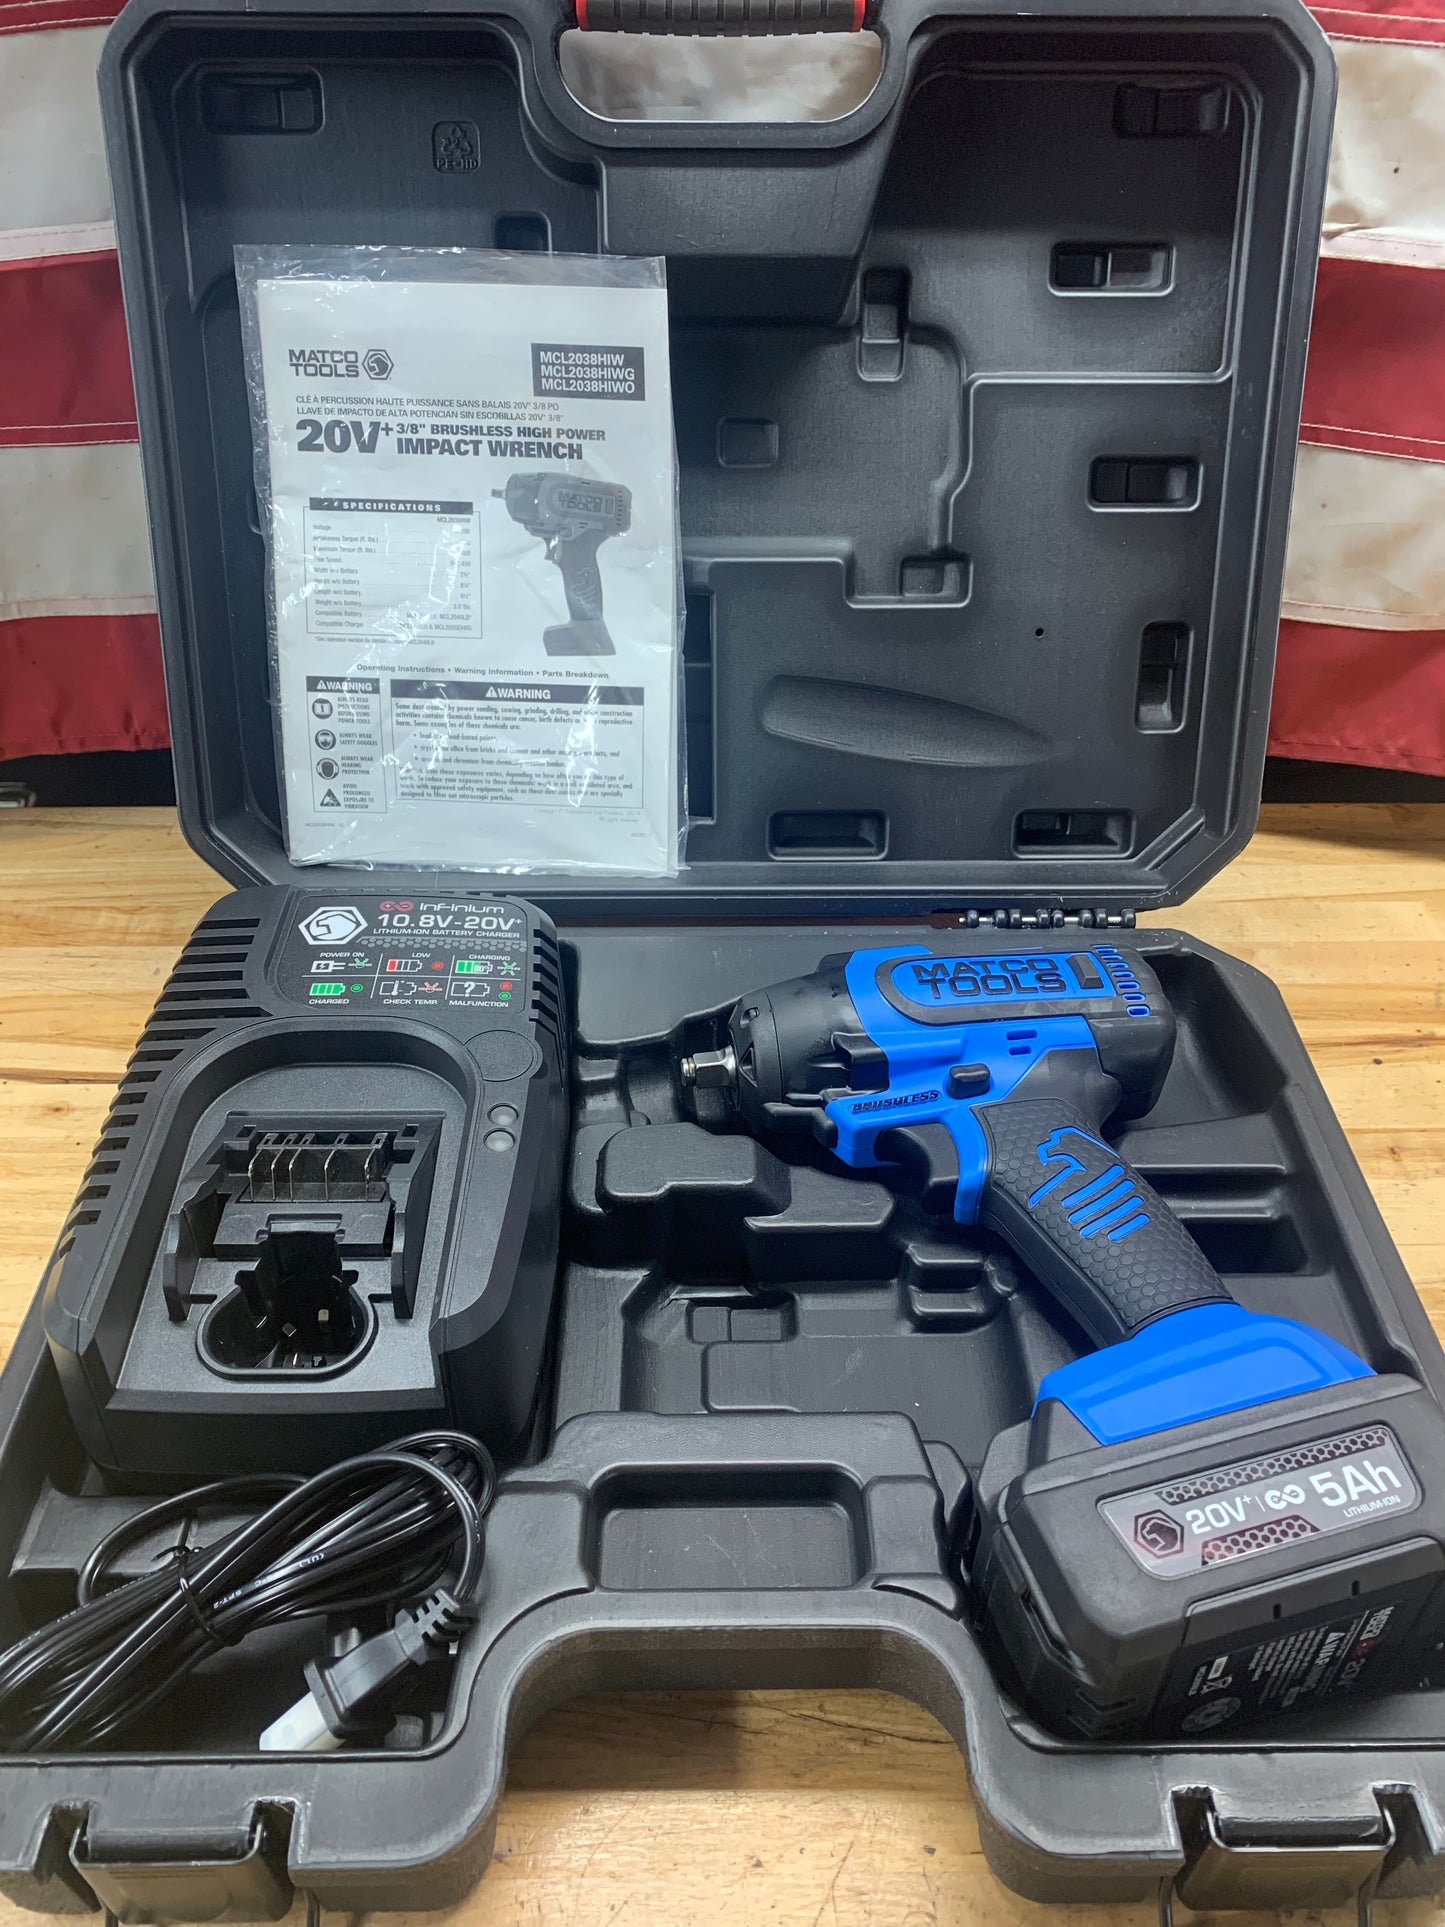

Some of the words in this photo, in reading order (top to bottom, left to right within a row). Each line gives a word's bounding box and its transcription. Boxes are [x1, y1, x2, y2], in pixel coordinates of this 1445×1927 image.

[288, 349, 359, 364] MATCO
[540, 351, 625, 366] MCL2038HIW
[289, 363, 360, 378] TOOLS
[540, 364, 635, 380] MCL2038HIWG
[541, 378, 635, 394] MCL2038HIWO
[295, 393, 311, 404] CLÉ
[320, 396, 374, 405] PERCUSSION
[376, 397, 404, 406] HAUTE
[406, 398, 454, 408] PUISSANCE
[456, 400, 480, 408] SANS
[482, 400, 512, 409] BALAIS
[533, 402, 546, 410] 3/8
[548, 402, 559, 411] PO
[296, 406, 322, 415] LLAVE
[324, 407, 336, 415] DE
[337, 408, 374, 416] IMPACTO
[376, 408, 387, 416] DE
[388, 409, 408, 417] ALTA
[410, 410, 458, 419] POTENCIAN
[460, 410, 474, 419] SIN
[476, 412, 526, 421] ESCOBILLAS
[396, 423, 426, 435] 3/8"
[430, 424, 512, 437] BRUSHLESS
[517, 427, 552, 439] HIGH
[556, 428, 606, 441] POWER
[396, 438, 482, 456] IMPACT
[488, 440, 583, 460] WRENCH
[558, 490, 602, 504] MATCO
[342, 502, 441, 512] SPECIFICATIONS
[560, 500, 602, 512] TOOLS
[356, 664, 396, 673] Operating
[398, 665, 445, 673] Instructions
[454, 667, 486, 676] Warning
[488, 668, 533, 676] Information
[565, 670, 609, 679] Breakdown
[326, 681, 373, 692] WARNING
[497, 687, 551, 700] WARNING
[373, 928, 428, 937] LITHIUM-ION
[432, 929, 474, 938] BATTERY
[475, 930, 520, 939] CHARGER
[468, 954, 511, 962] CHARGING
[911, 958, 1059, 980] MATCO
[918, 973, 1067, 999] TOOLS
[449, 1000, 509, 1008] MALFUNCTION
[852, 1091, 939, 1114] BRUSHLESS
[1309, 1460, 1402, 1507] 5Ah
[1342, 1494, 1401, 1518] LITHIUM-ION
